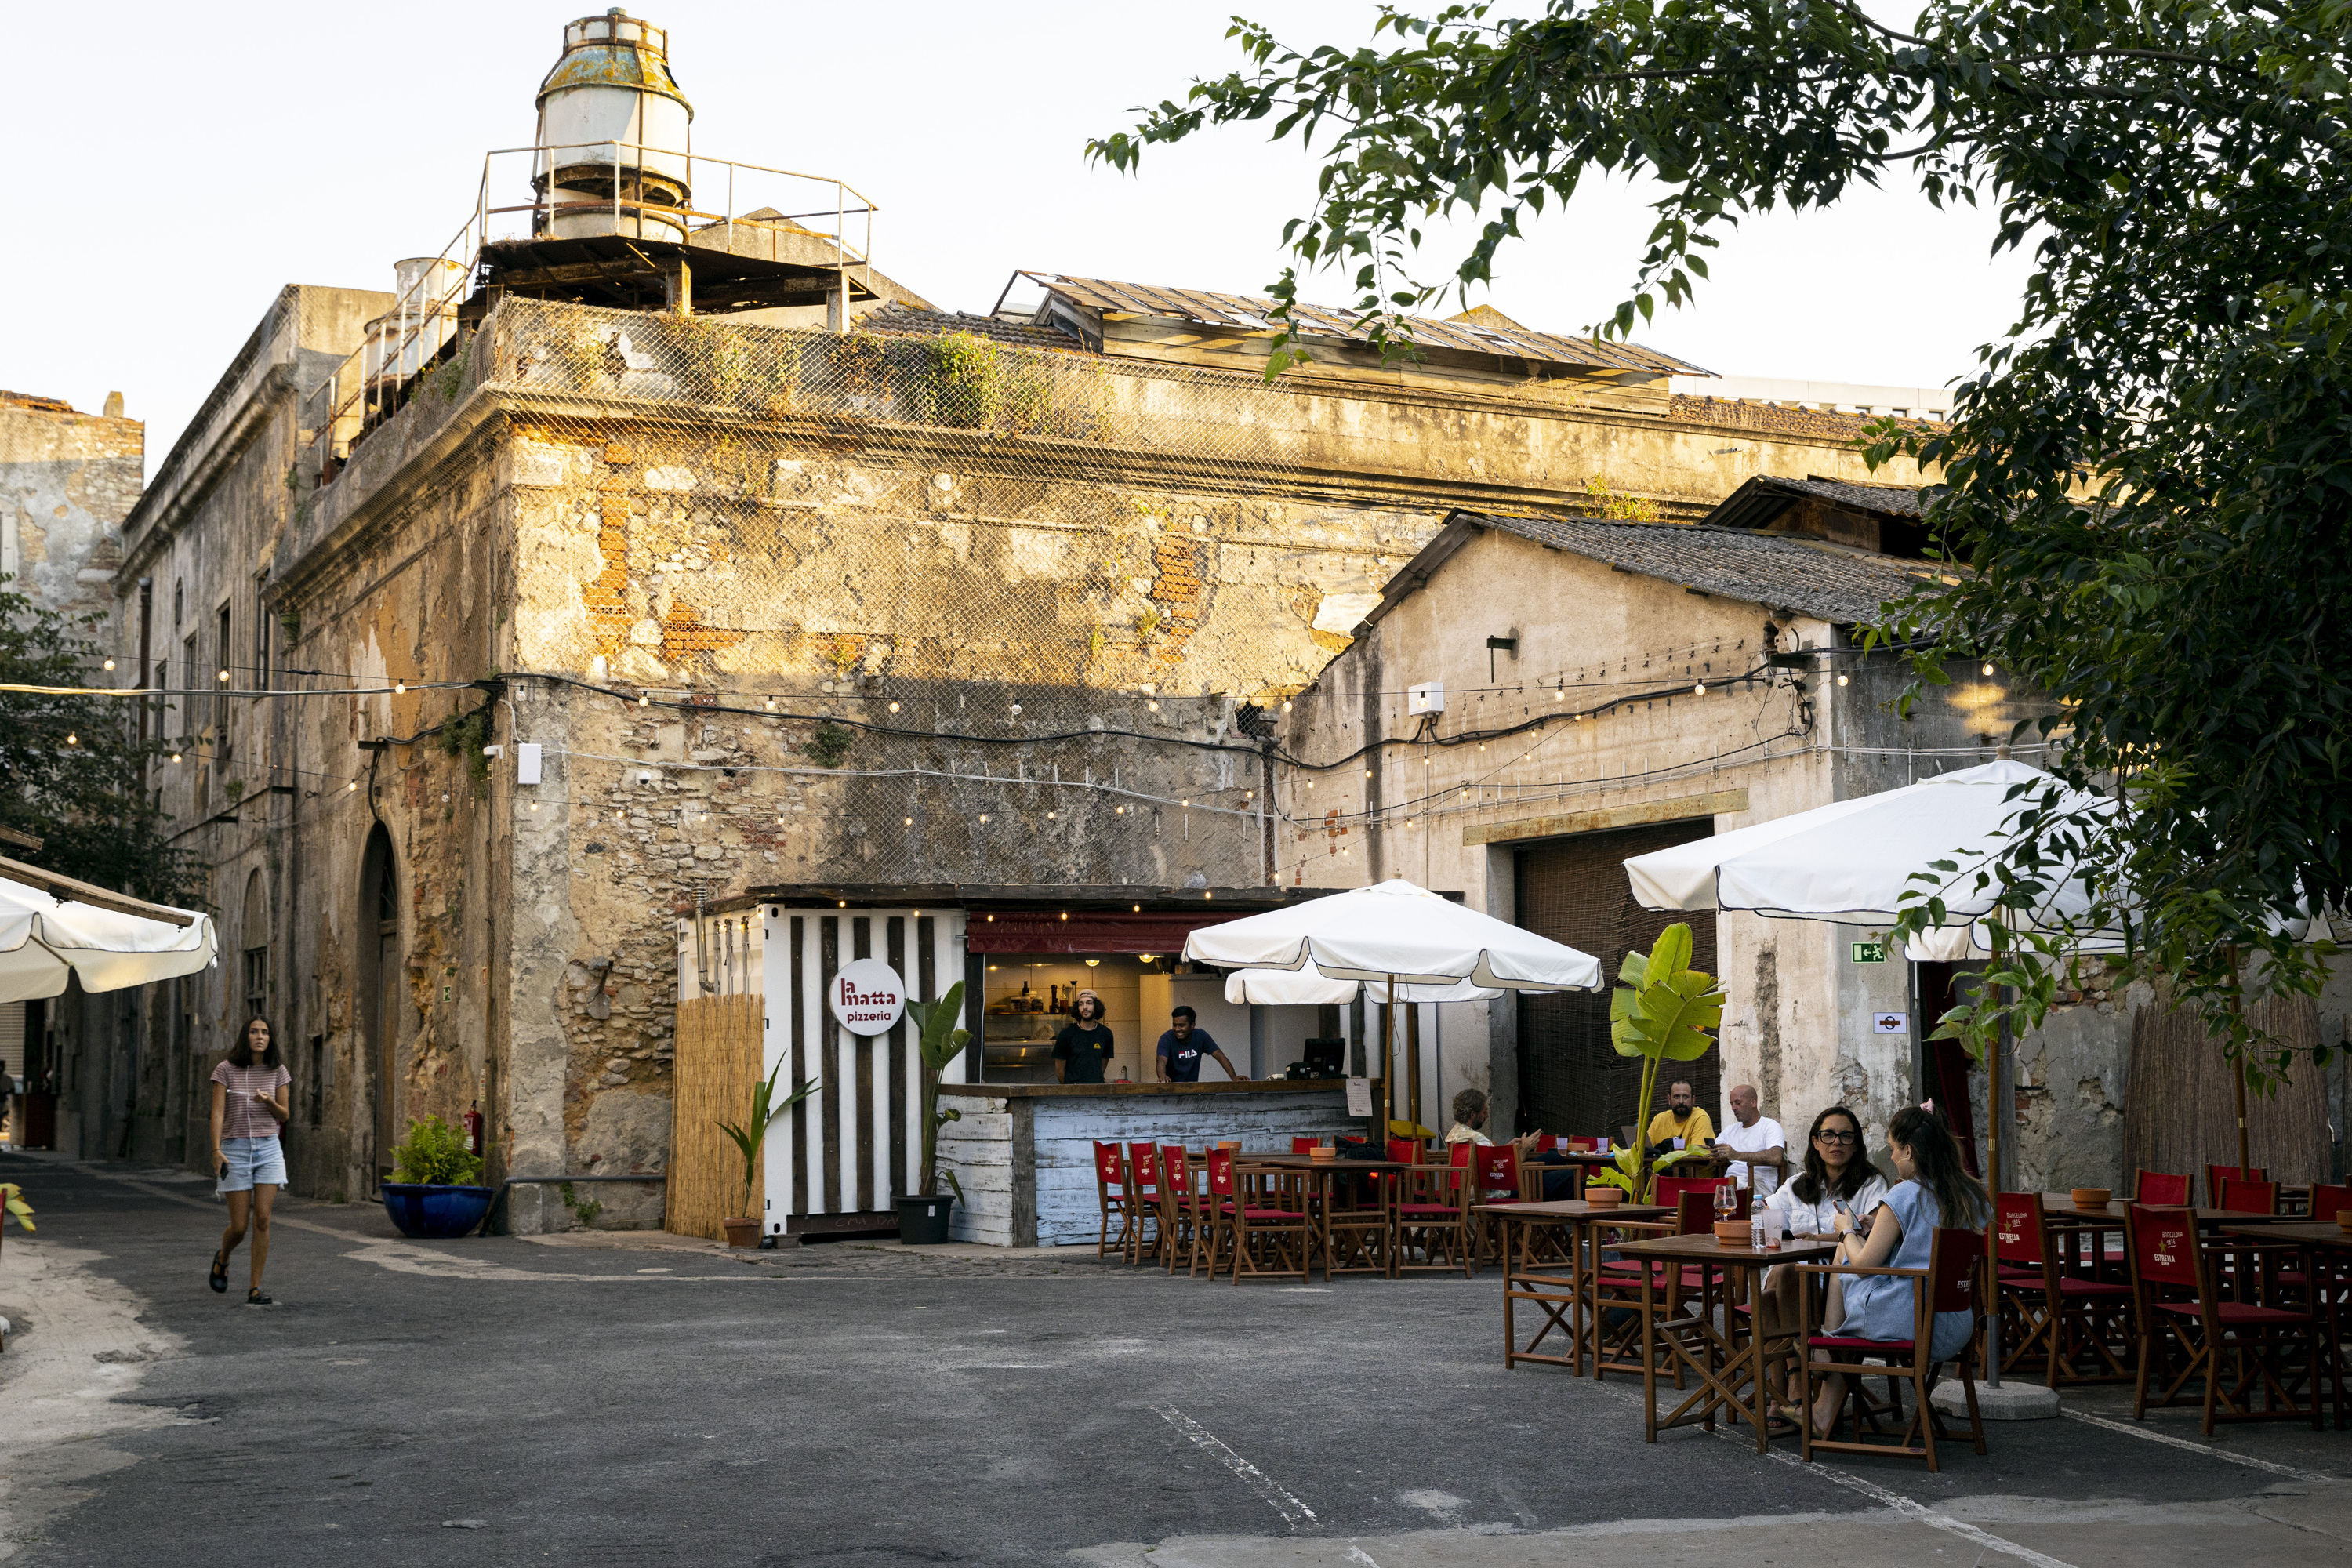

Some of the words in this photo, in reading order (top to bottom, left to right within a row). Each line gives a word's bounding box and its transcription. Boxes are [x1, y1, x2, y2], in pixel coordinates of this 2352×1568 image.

[841, 978, 855, 998] la
[842, 991, 895, 1005] matta
[848, 1011, 891, 1024] pizzeria
[1179, 1049, 1197, 1058] FILA
[2154, 1254, 2175, 1262] ESTRELLA
